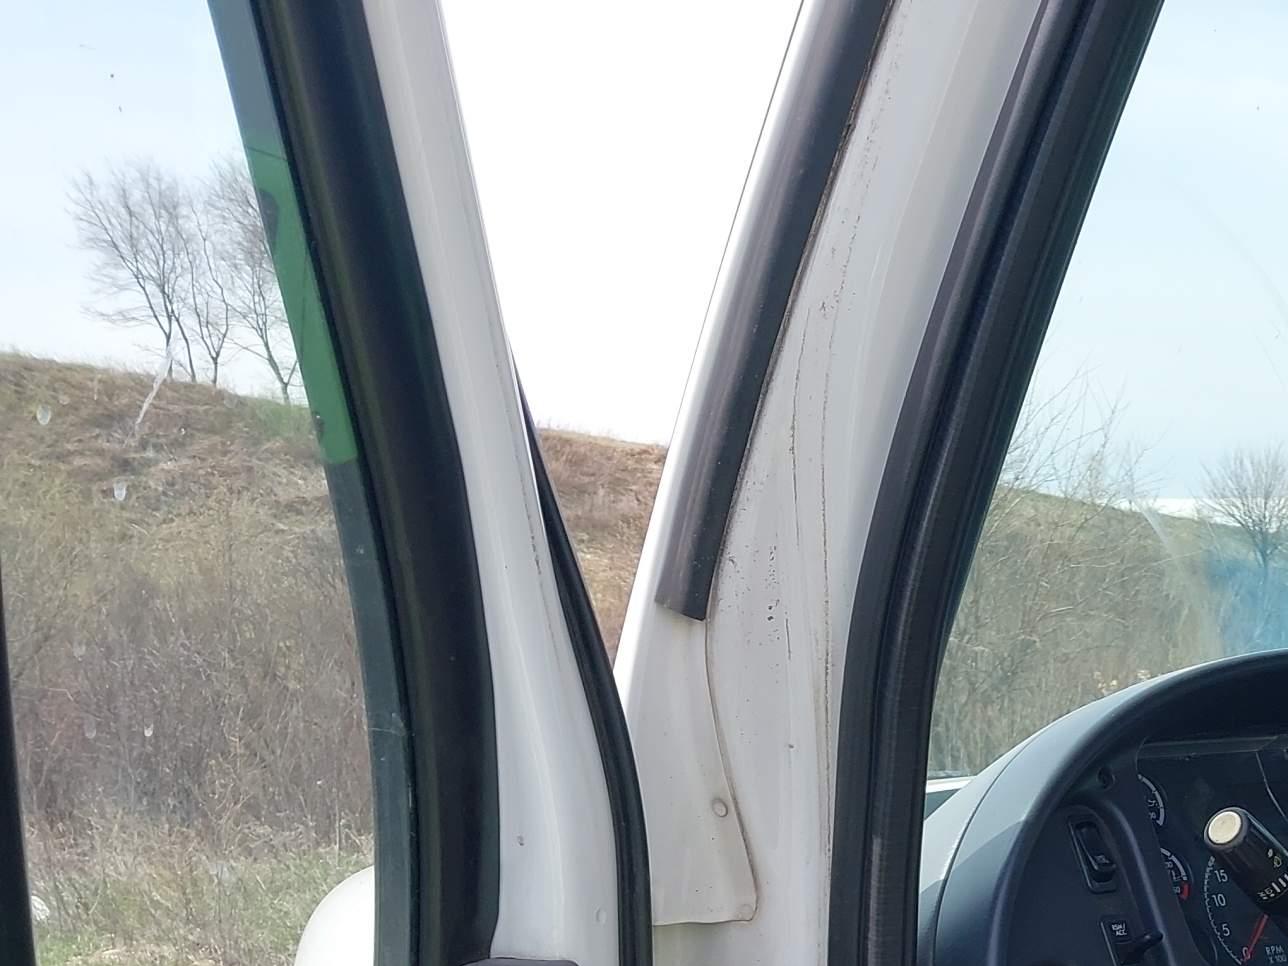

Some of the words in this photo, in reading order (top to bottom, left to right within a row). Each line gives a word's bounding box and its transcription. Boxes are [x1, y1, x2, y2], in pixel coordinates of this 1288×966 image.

[1215, 869, 1228, 882] 15
[1212, 893, 1226, 907] 10
[1221, 923, 1231, 937] 5
[1265, 944, 1285, 956] RPM
